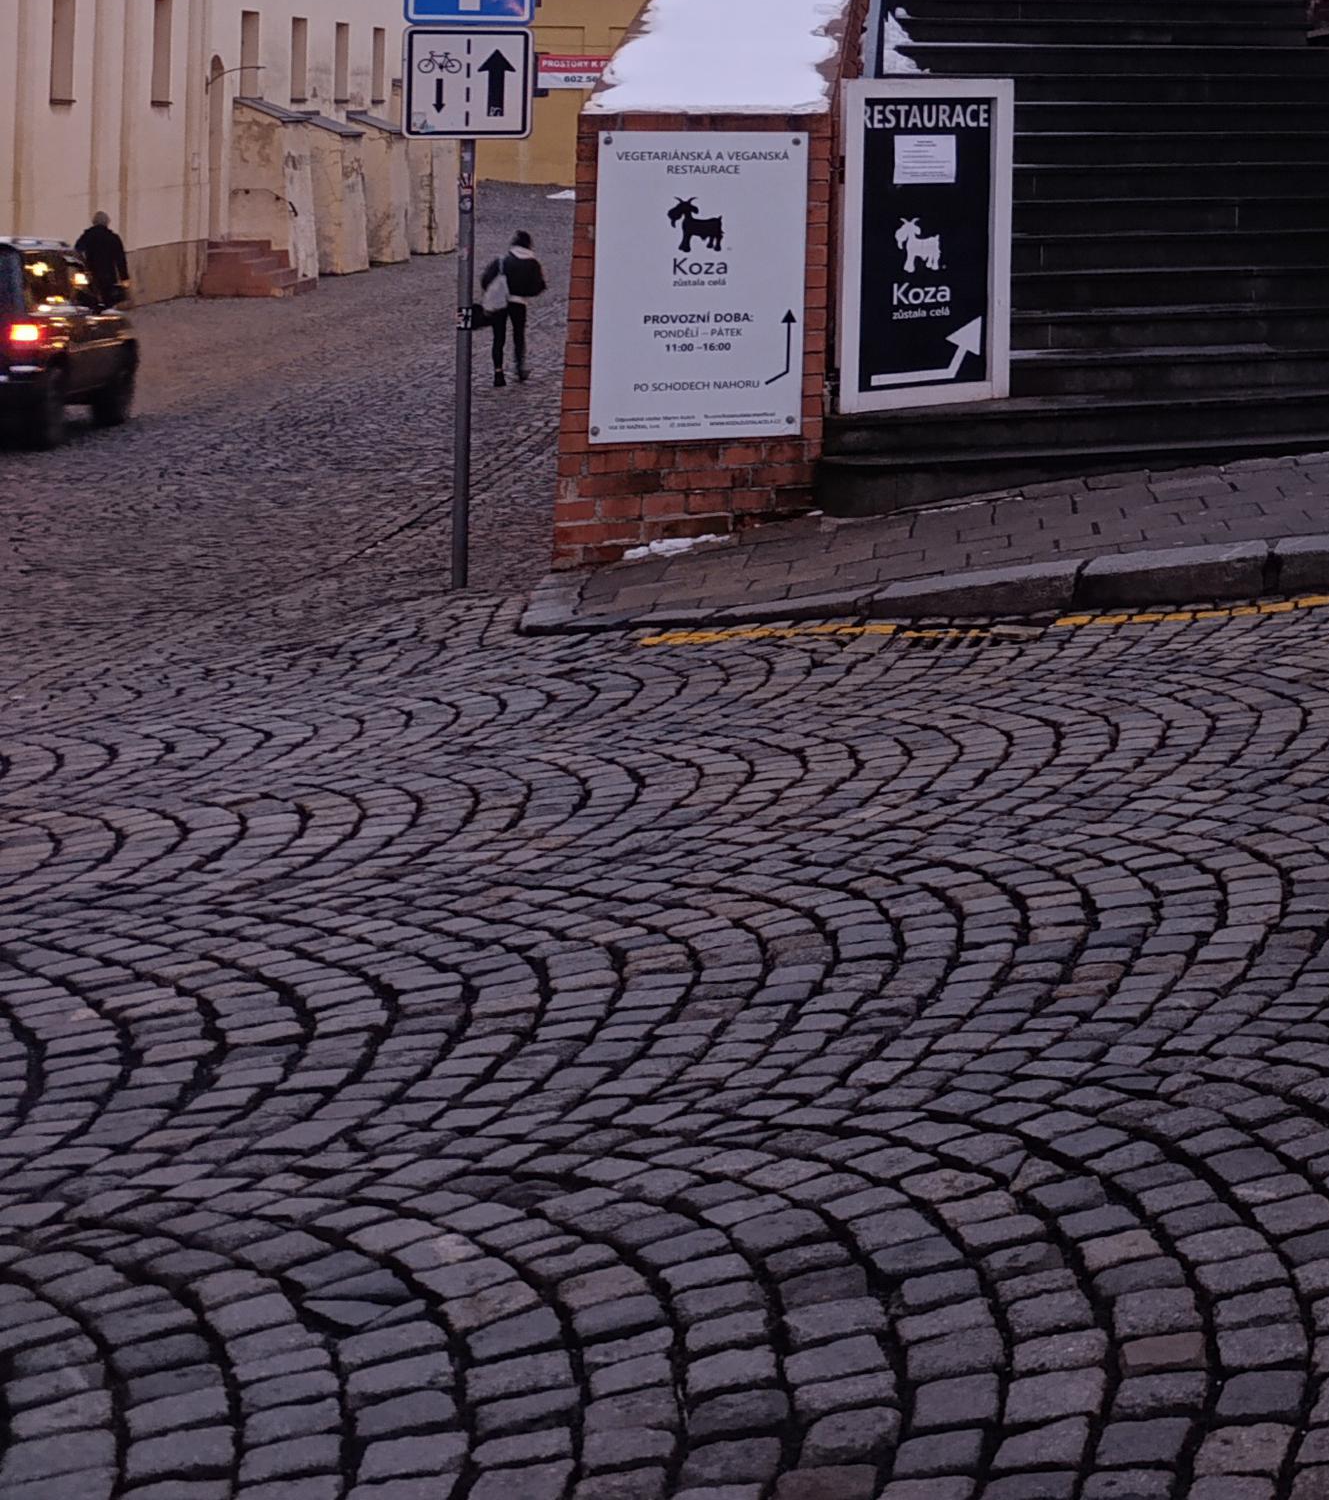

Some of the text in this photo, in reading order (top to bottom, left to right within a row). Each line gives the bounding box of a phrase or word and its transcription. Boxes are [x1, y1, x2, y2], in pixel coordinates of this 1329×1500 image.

[864, 104, 989, 129] RESTAURACE
[616, 149, 789, 161] VEGETARIÁNSKÁ A VEGANSKÁ
[667, 164, 740, 175] RESTAURACE
[672, 257, 728, 276] Koza
[673, 277, 726, 287] zůstala celá
[892, 282, 951, 306] Koza
[643, 311, 754, 325] PROVOZNÍ DOBA:
[892, 306, 950, 320] zůstala celá
[654, 327, 699, 339] PONDĚLÍ
[711, 326, 742, 338] PÁTEK
[665, 343, 694, 353] 11:00
[634, 379, 760, 392] PO SCHODECH NAHORU
